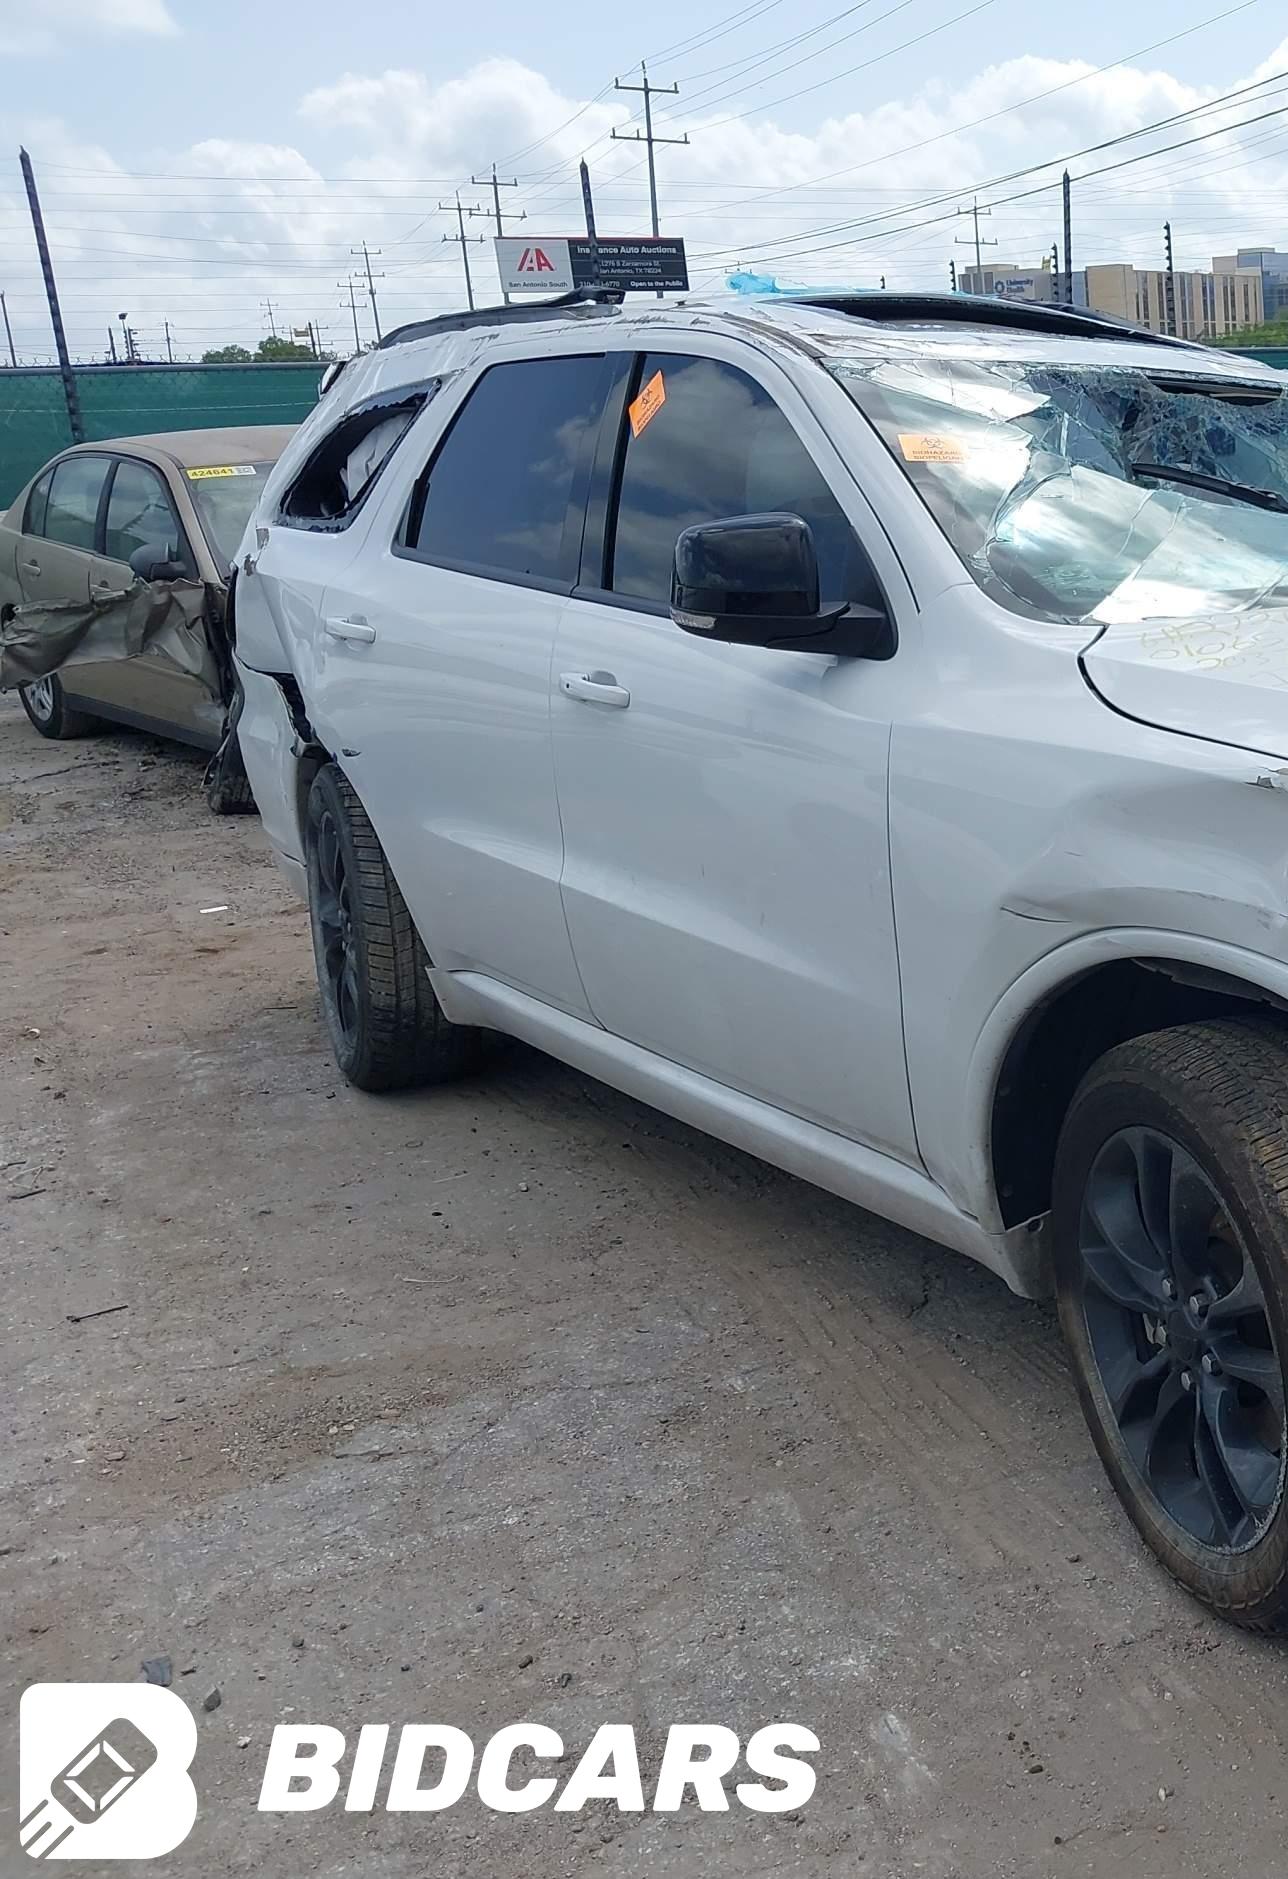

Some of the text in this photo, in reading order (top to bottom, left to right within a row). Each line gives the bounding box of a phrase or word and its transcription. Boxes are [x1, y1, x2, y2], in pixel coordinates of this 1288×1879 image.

[577, 245, 677, 254] Insance Auto Auctions
